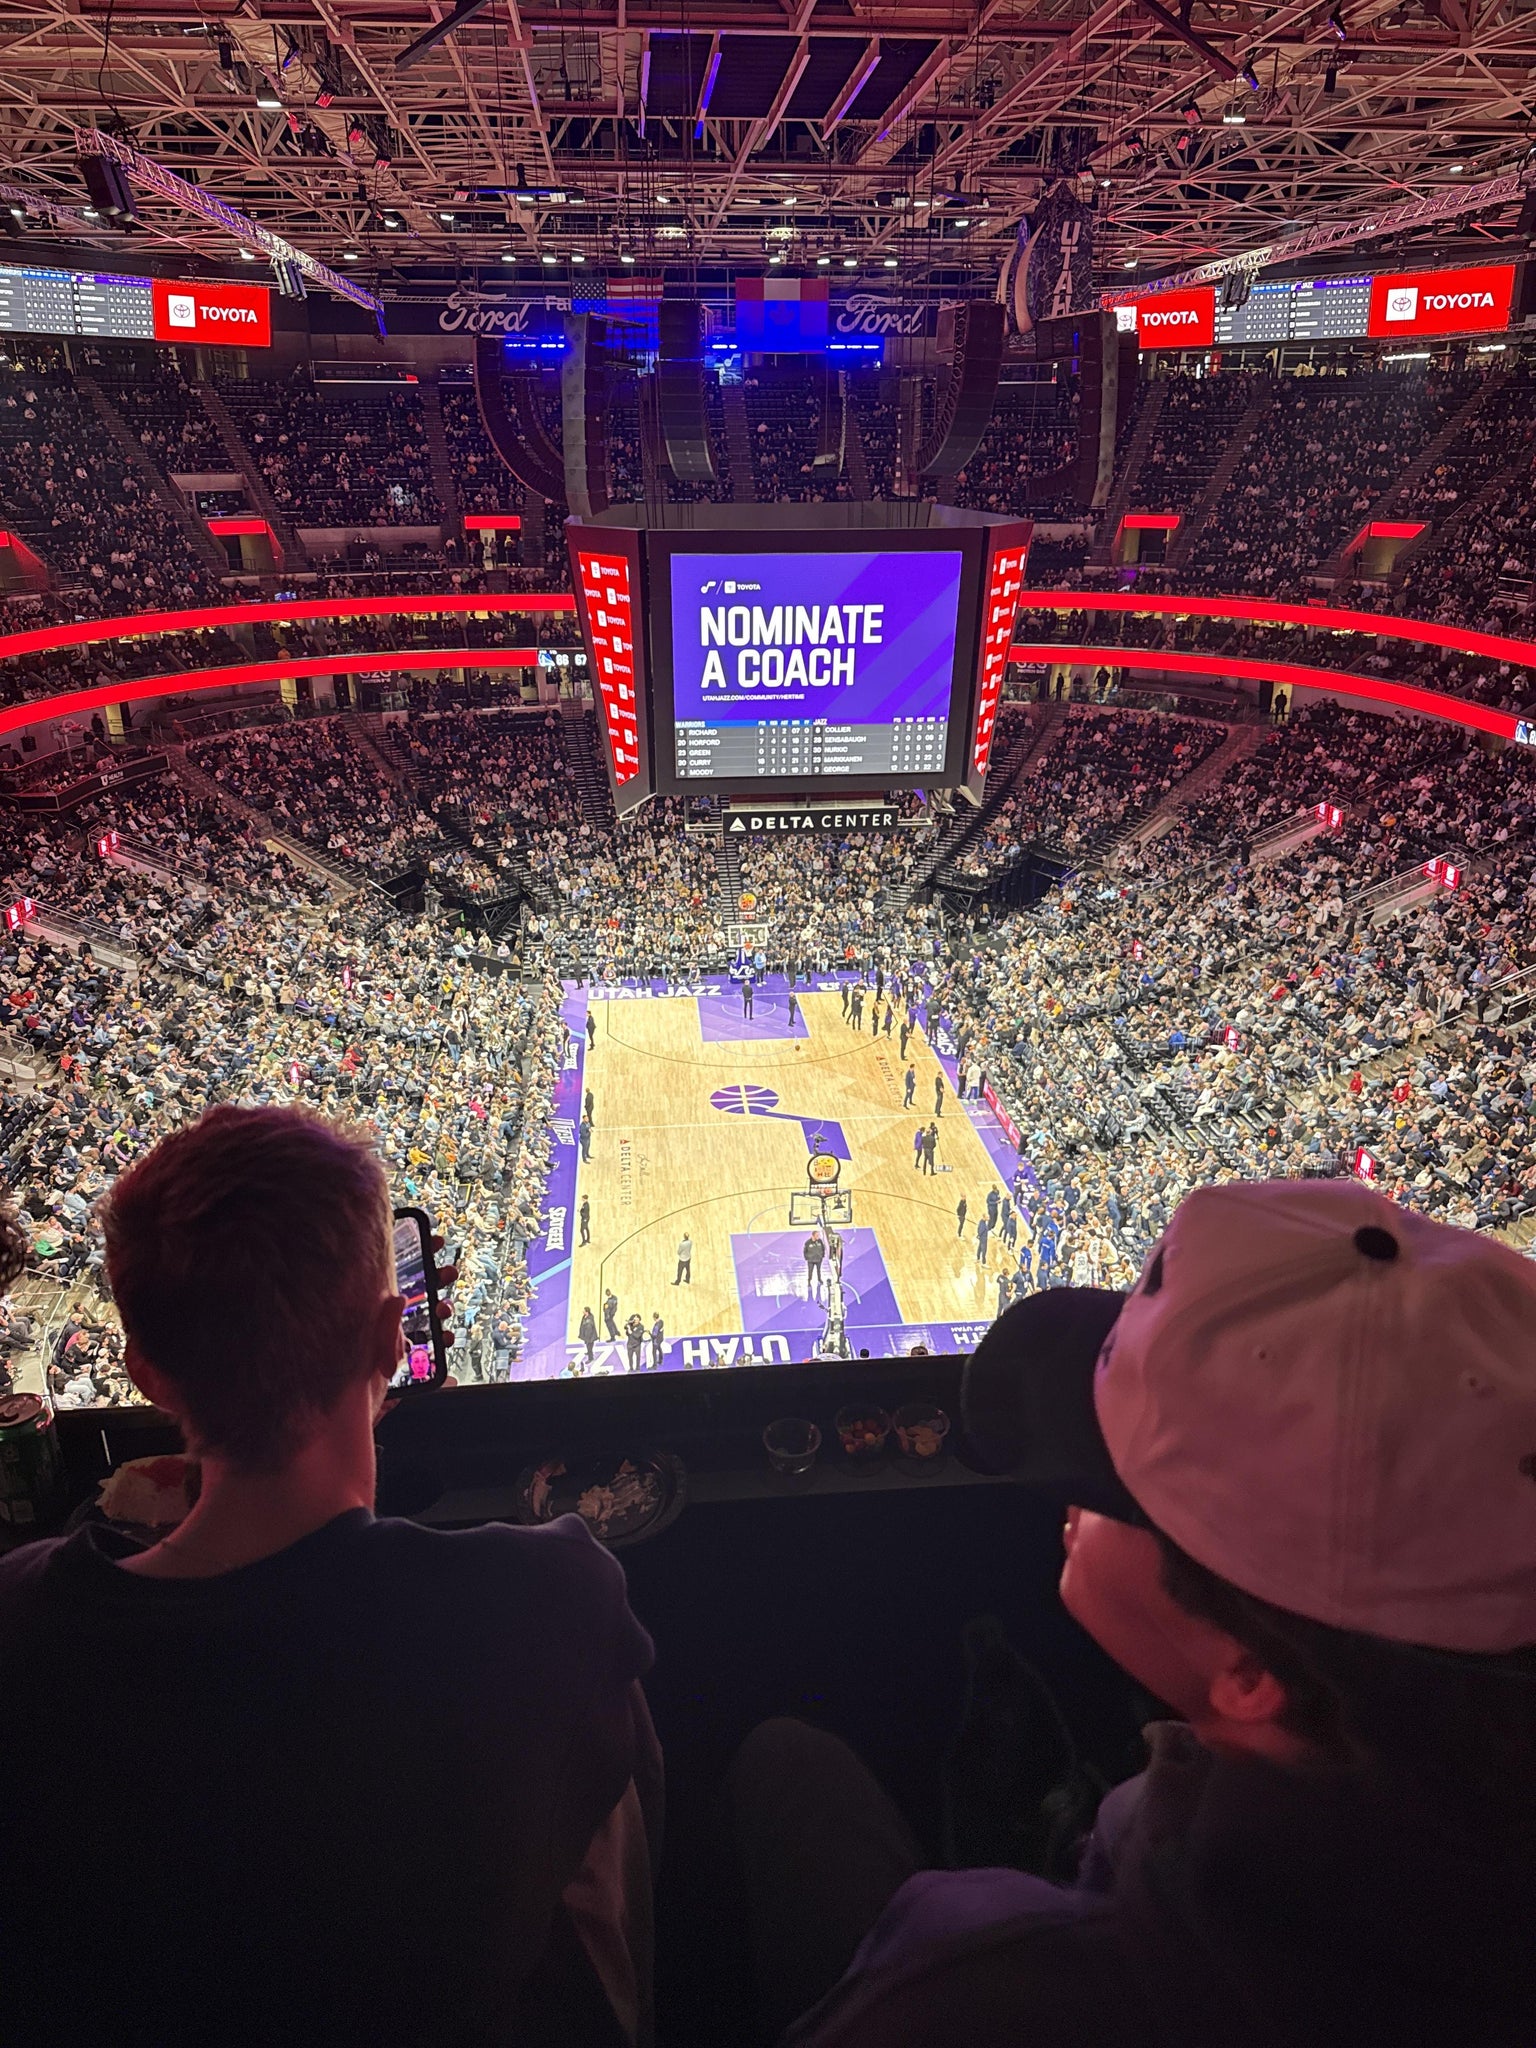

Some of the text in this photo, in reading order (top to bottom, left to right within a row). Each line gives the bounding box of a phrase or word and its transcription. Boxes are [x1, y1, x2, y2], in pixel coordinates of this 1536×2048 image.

[1052, 222, 1081, 316] UTAH
[1423, 292, 1494, 310] TOYOTA
[200, 306, 258, 323] TOYOTA
[438, 292, 530, 332] Ford
[836, 294, 926, 334] Ford
[1142, 310, 1198, 327] TOYOTA
[601, 567, 620, 576] TOYOTA
[584, 589, 601, 598] OYOTA
[616, 593, 630, 602] TOYO
[607, 616, 626, 626] TOYOTA
[701, 604, 884, 646] NOMINATE
[574, 654, 587, 666] 67
[701, 648, 855, 688] A COACH
[613, 664, 631, 674] TOYOTA
[751, 814, 892, 830] DELTA CENTER
[587, 985, 722, 1000] UTAH JAZZ
[881, 1061, 894, 1082] DELTA
[620, 1146, 632, 1206] DELTA CENTER
[683, 1335, 791, 1368] UTAH
